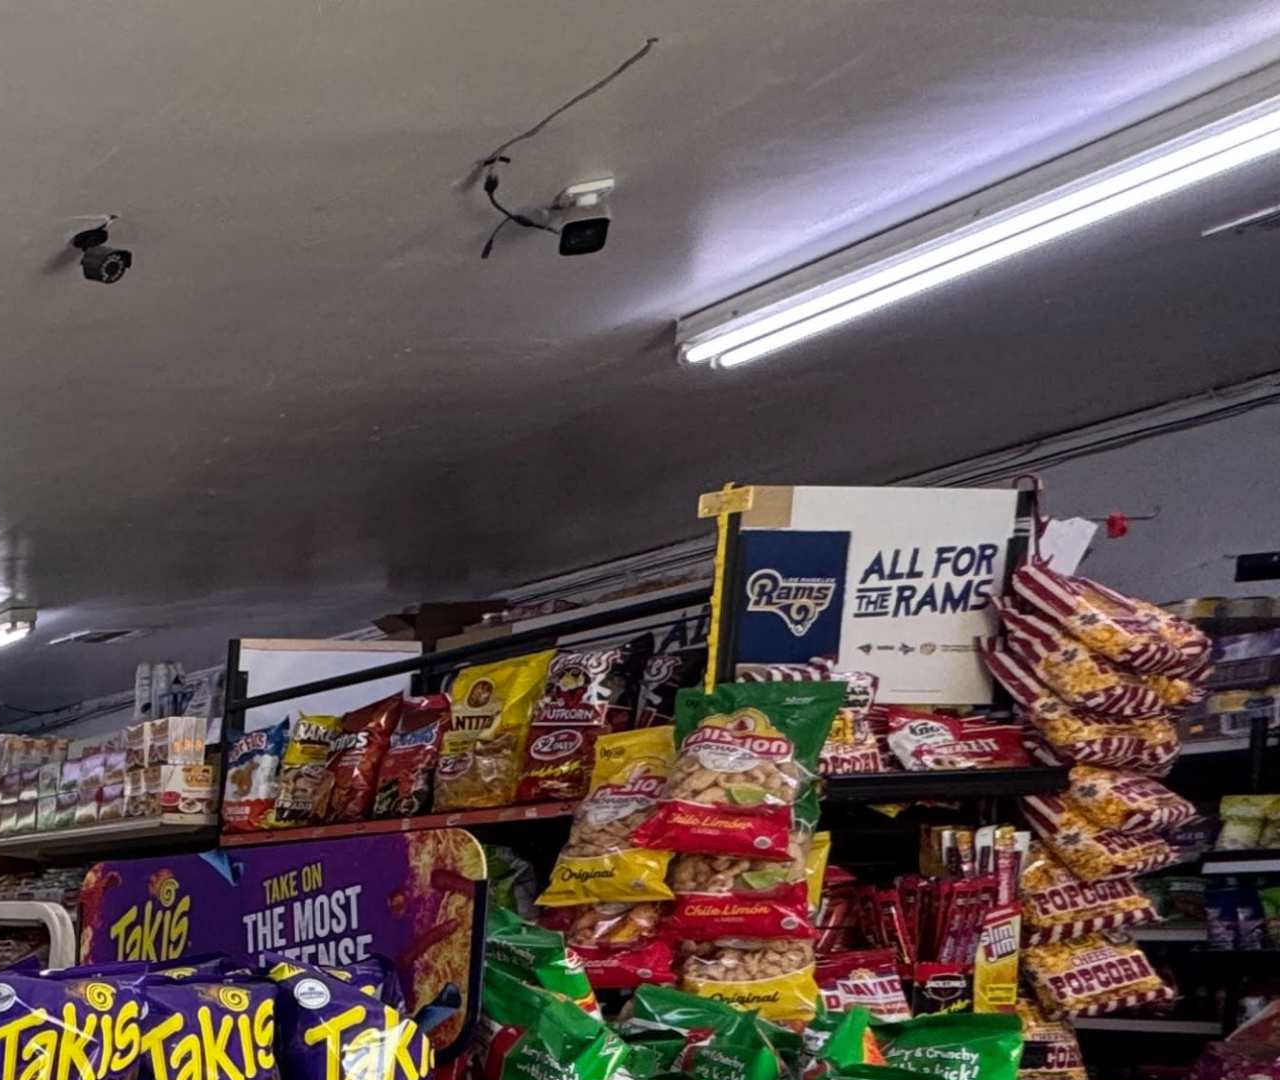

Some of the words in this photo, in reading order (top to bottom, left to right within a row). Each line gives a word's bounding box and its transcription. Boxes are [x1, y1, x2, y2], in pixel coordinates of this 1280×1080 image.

[860, 549, 923, 584] ALL
[933, 545, 997, 578] FOR
[749, 570, 831, 608] Rams
[855, 595, 889, 612] THE
[892, 580, 992, 617] RAMS
[263, 871, 298, 905] TAKE
[301, 863, 323, 893] ON
[561, 866, 615, 881] Original
[1033, 878, 1137, 916] POPCORN
[110, 893, 191, 963] Takis
[243, 906, 287, 954] THE
[293, 885, 362, 943] MOST
[1048, 955, 1153, 1000] POPCORN
[926, 1047, 979, 1063] Crunchy
